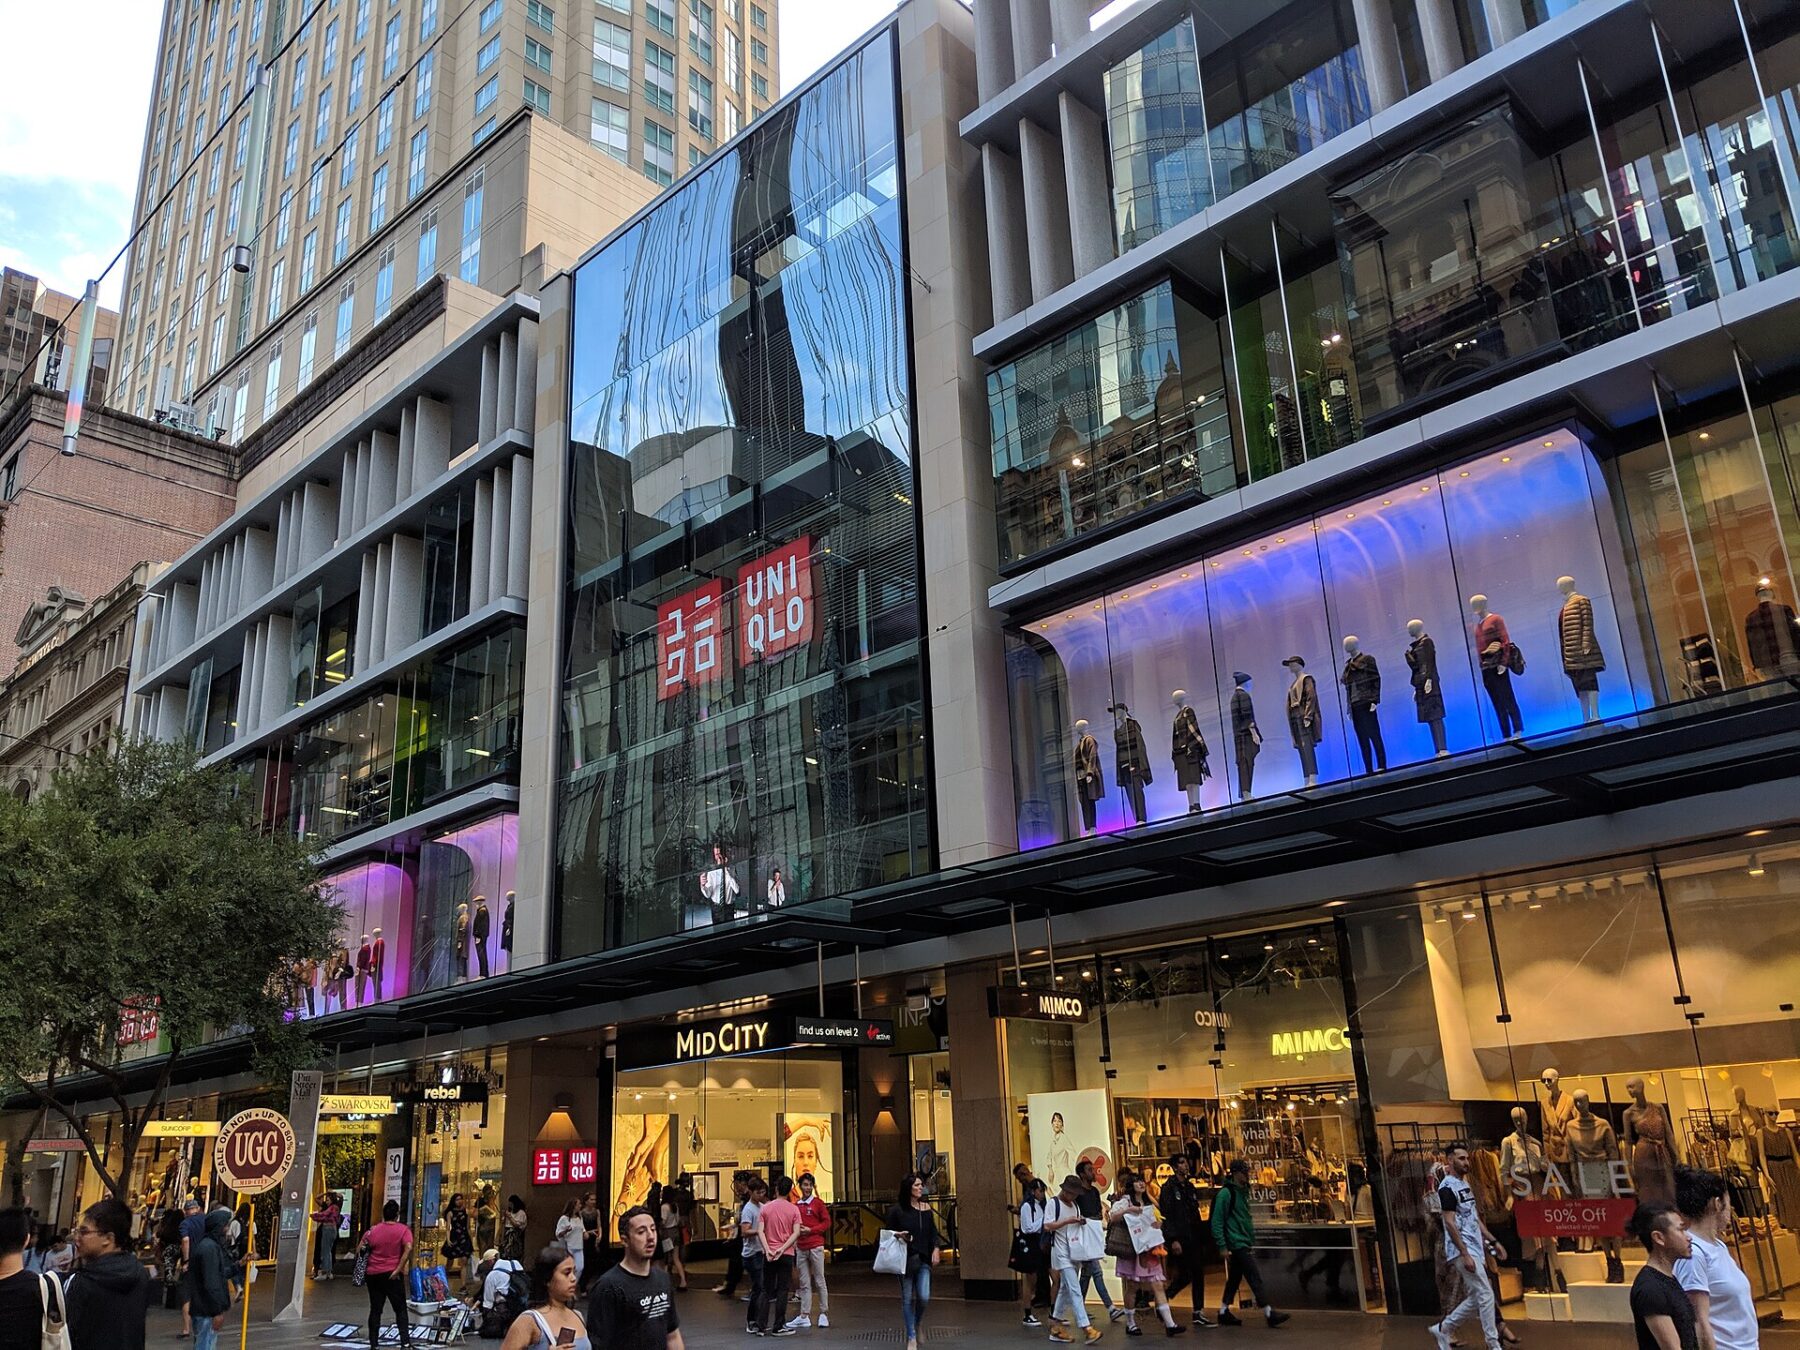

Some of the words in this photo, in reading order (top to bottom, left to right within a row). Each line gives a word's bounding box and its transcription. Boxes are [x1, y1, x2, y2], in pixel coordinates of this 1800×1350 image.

[746, 555, 797, 607] UNI
[747, 596, 804, 652] QLO
[1039, 995, 1082, 1019] MIMCO
[799, 1025, 814, 1035] find
[825, 1028, 835, 1036] on
[835, 1026, 852, 1037] level
[853, 1027, 859, 1037] 2
[424, 1085, 461, 1100] rebel
[331, 1099, 390, 1110] SWAROVSKI
[230, 1111, 253, 1128] NOW
[262, 1111, 275, 1119] UP
[275, 1116, 287, 1129] TO
[219, 1129, 231, 1144] ON
[284, 1129, 294, 1151] 80%
[234, 1130, 279, 1167] UGG
[1241, 1144, 1270, 1157] your
[217, 1147, 227, 1174] SALE
[281, 1153, 292, 1173] OFF
[571, 1152, 592, 1165] UNI
[571, 1166, 593, 1180] QLO
[1510, 1159, 1635, 1197] SALE
[1544, 1208, 1577, 1223] 50%
[1582, 1207, 1607, 1222] Off
